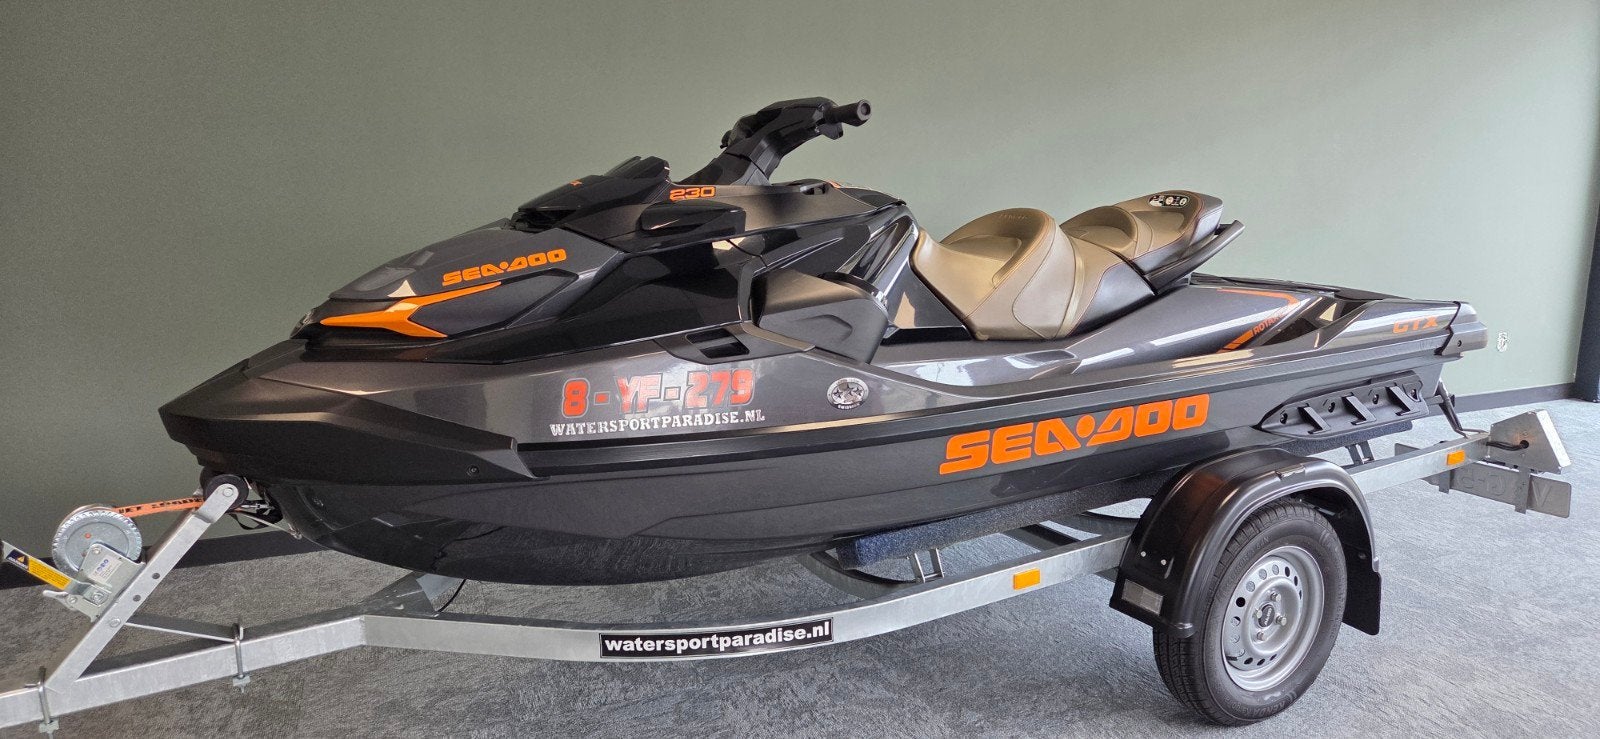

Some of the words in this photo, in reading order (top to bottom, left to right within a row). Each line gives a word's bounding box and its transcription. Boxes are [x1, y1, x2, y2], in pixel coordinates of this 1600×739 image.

[670, 186, 716, 201] 230
[1392, 316, 1438, 334] GTX
[549, 409, 766, 437] WATERSPORTPARADISE.NL
[605, 621, 829, 653] watersportparadise.nl
